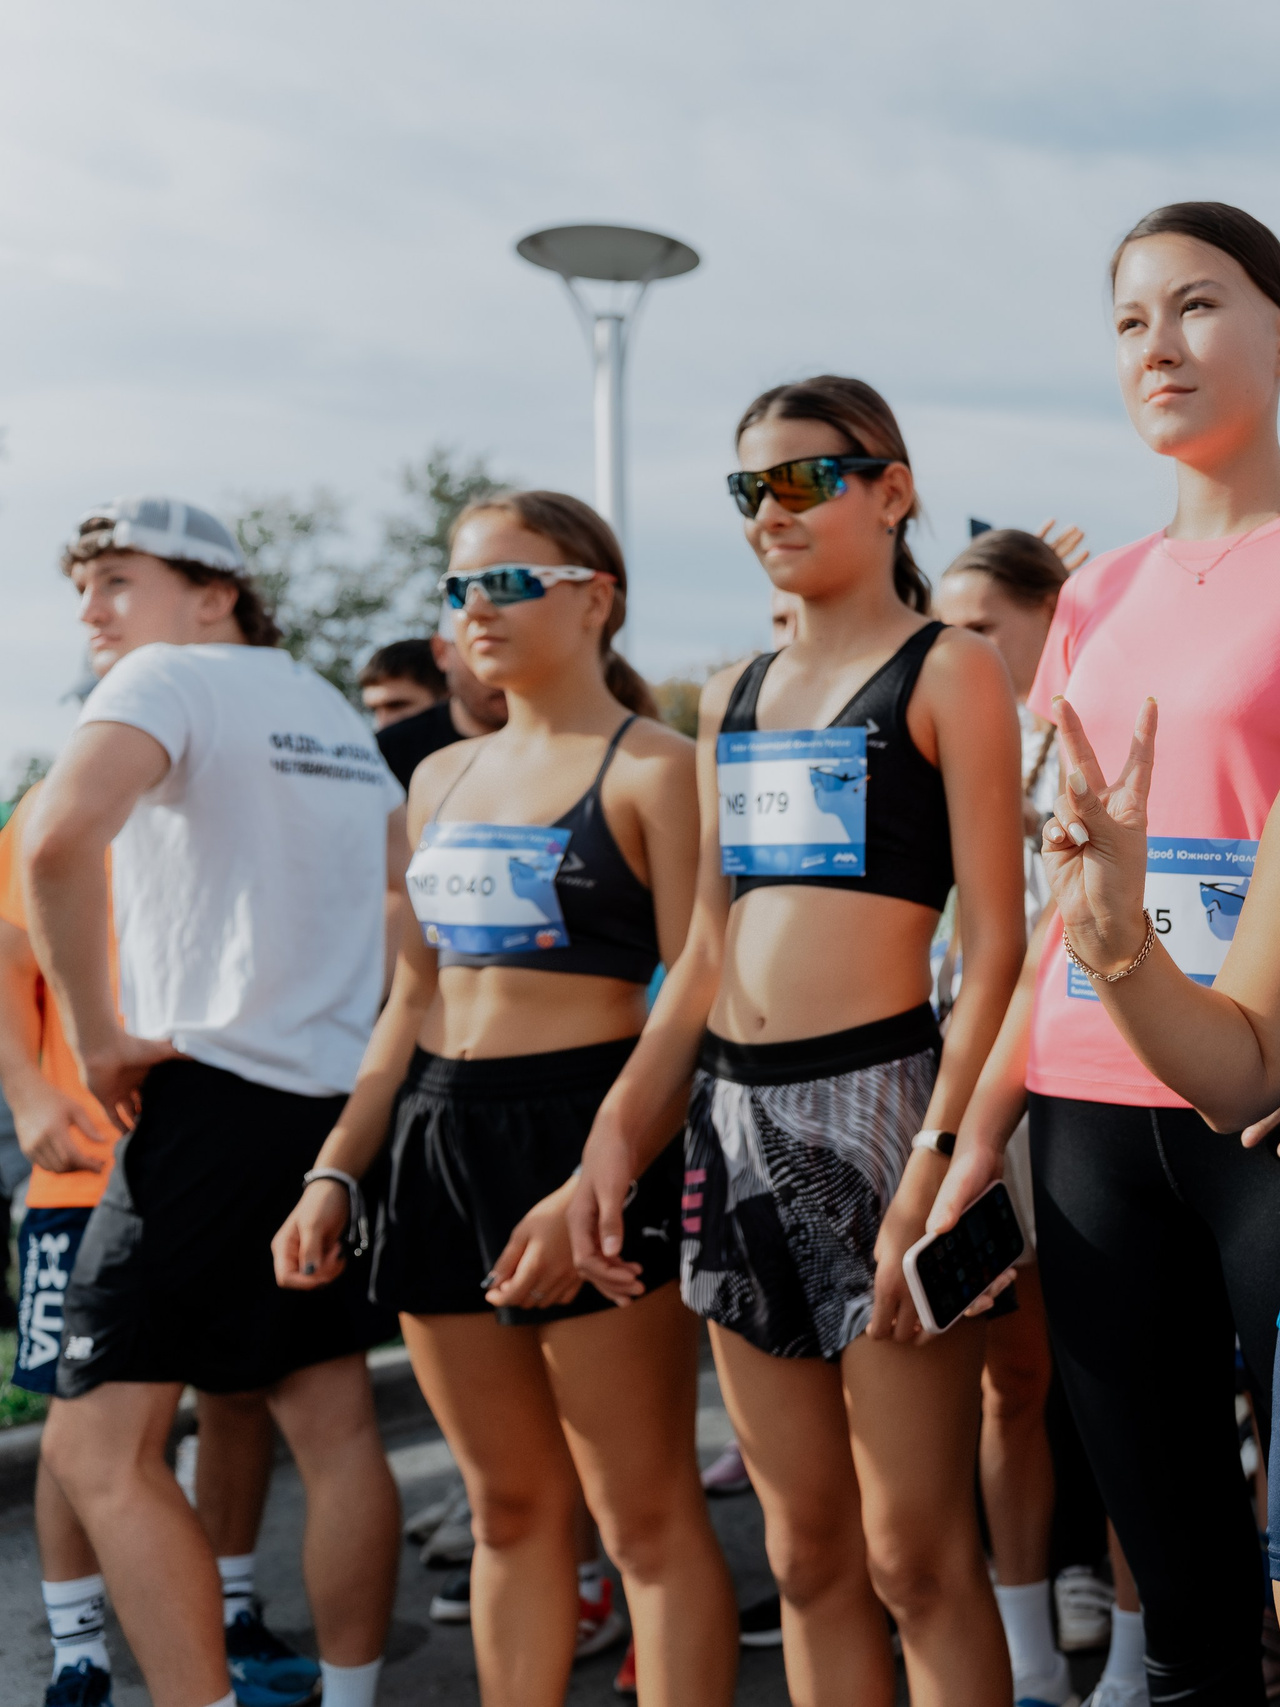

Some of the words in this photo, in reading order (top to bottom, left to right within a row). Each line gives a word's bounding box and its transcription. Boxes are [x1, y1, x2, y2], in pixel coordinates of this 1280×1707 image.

[756, 792, 790, 815] 179
[1177, 849, 1222, 862] Южного
[447, 874, 496, 897] 040
[1151, 908, 1172, 935] 5
